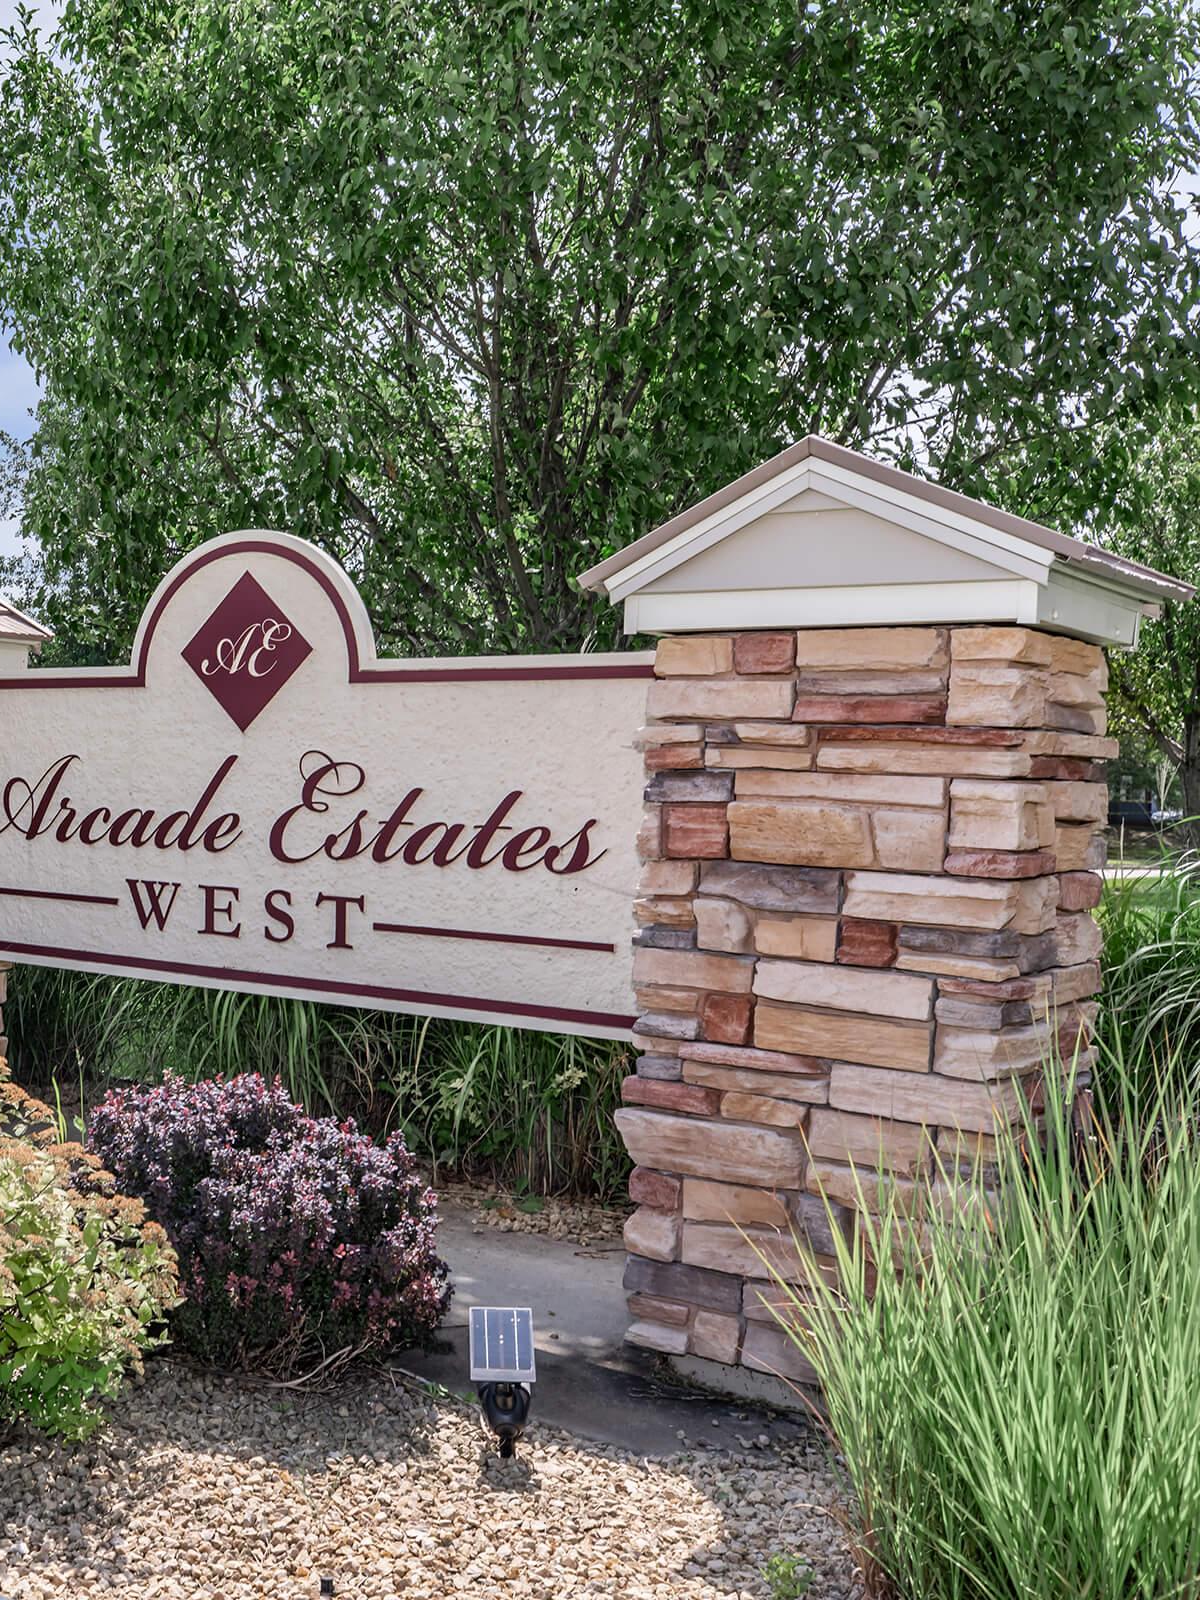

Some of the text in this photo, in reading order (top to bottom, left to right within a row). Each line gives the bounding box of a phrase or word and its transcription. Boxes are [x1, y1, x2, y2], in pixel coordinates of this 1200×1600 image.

[200, 618, 292, 678] AE
[269, 750, 607, 874] Estates
[125, 879, 367, 950] WEST
